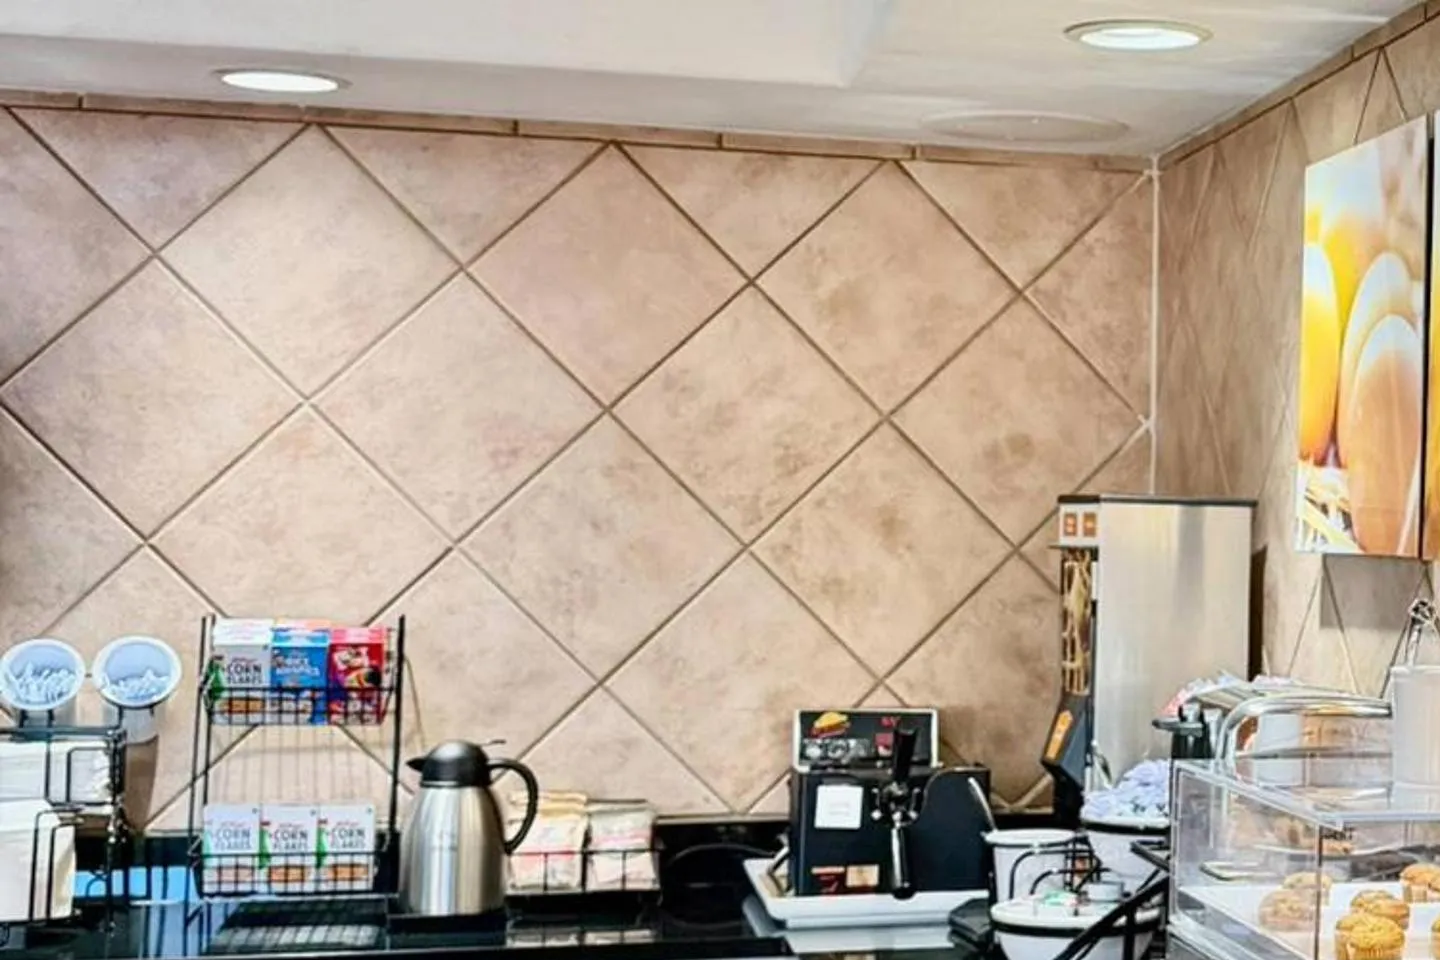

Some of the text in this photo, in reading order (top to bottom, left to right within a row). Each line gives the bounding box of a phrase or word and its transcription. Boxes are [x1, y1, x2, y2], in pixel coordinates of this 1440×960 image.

[227, 663, 262, 675] CORN
[216, 827, 251, 838] CORN
[274, 829, 308, 840] CORN
[331, 827, 364, 838] CORN
